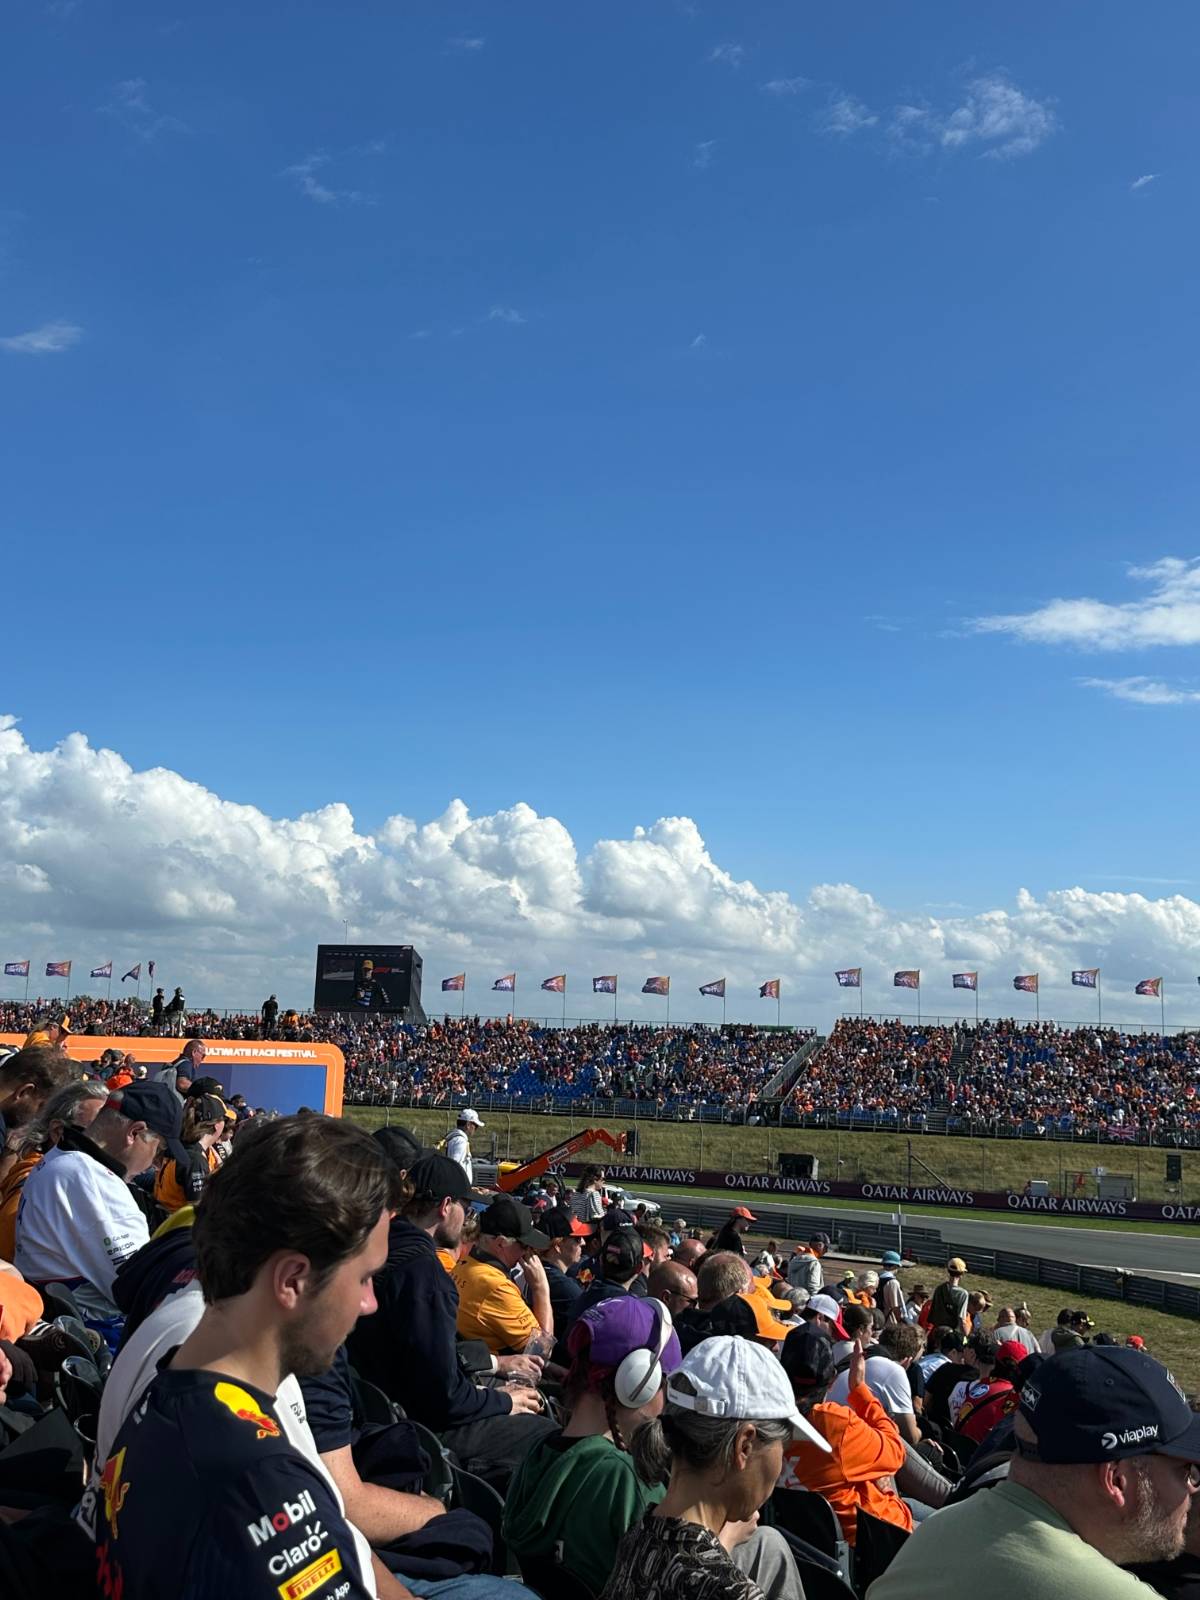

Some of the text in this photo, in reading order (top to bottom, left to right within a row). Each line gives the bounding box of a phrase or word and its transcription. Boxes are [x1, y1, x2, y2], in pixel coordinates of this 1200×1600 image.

[252, 1048, 275, 1057] RACE
[276, 1048, 317, 1058] FESTIVAL
[604, 1166, 695, 1183] ATAR AIRWAYS
[725, 1174, 831, 1193] QATAR AIRWAYS
[861, 1184, 974, 1204] QATAR AIRWAYS
[1007, 1194, 1126, 1215] QATAR AIRWAYS
[1119, 1424, 1159, 1444] viaplay
[248, 1489, 317, 1547] Mobil
[268, 1530, 323, 1575] Claro
[286, 1557, 335, 1600] PIRELLI
